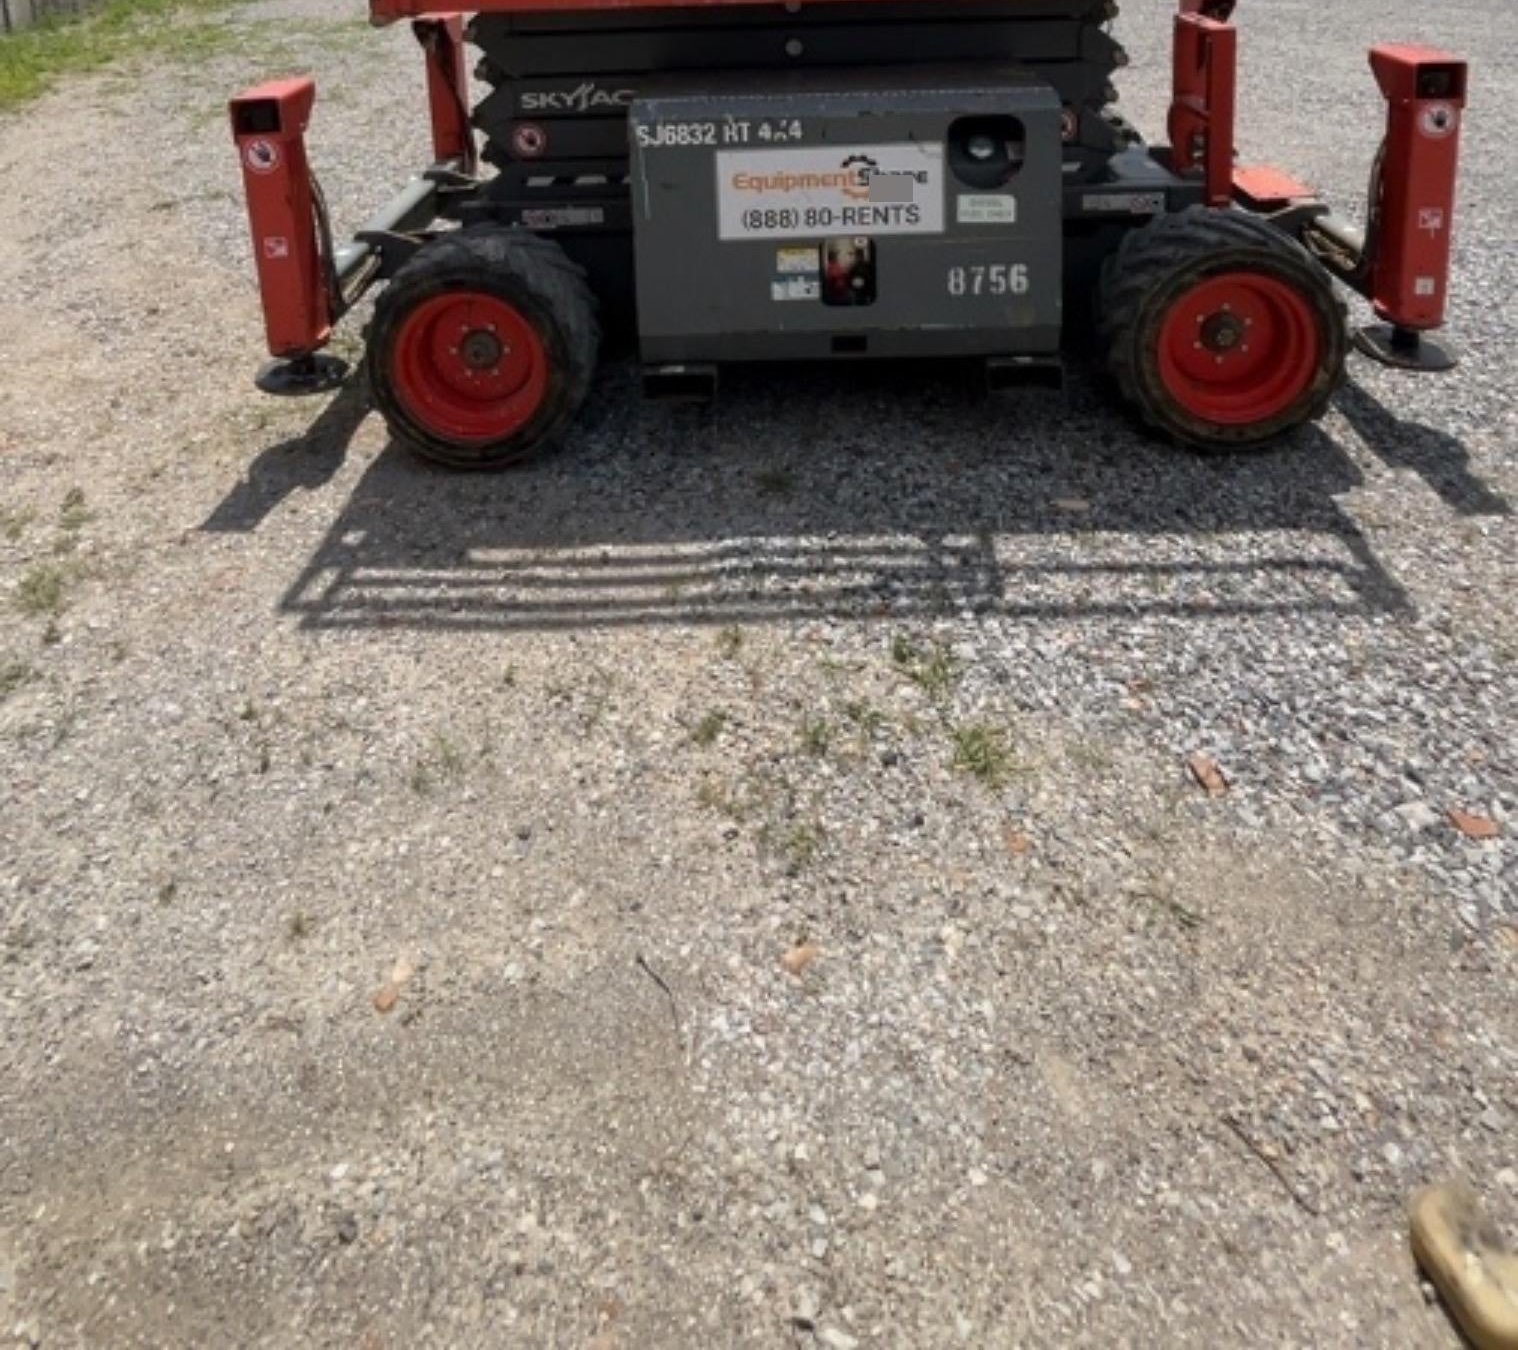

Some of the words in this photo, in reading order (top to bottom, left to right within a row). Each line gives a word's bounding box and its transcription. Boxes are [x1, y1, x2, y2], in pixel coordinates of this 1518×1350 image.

[520, 82, 638, 111] SKYJAC
[742, 207, 799, 231] (888)
[804, 203, 921, 227] 80-RENTS
[947, 263, 1030, 295] 8756
